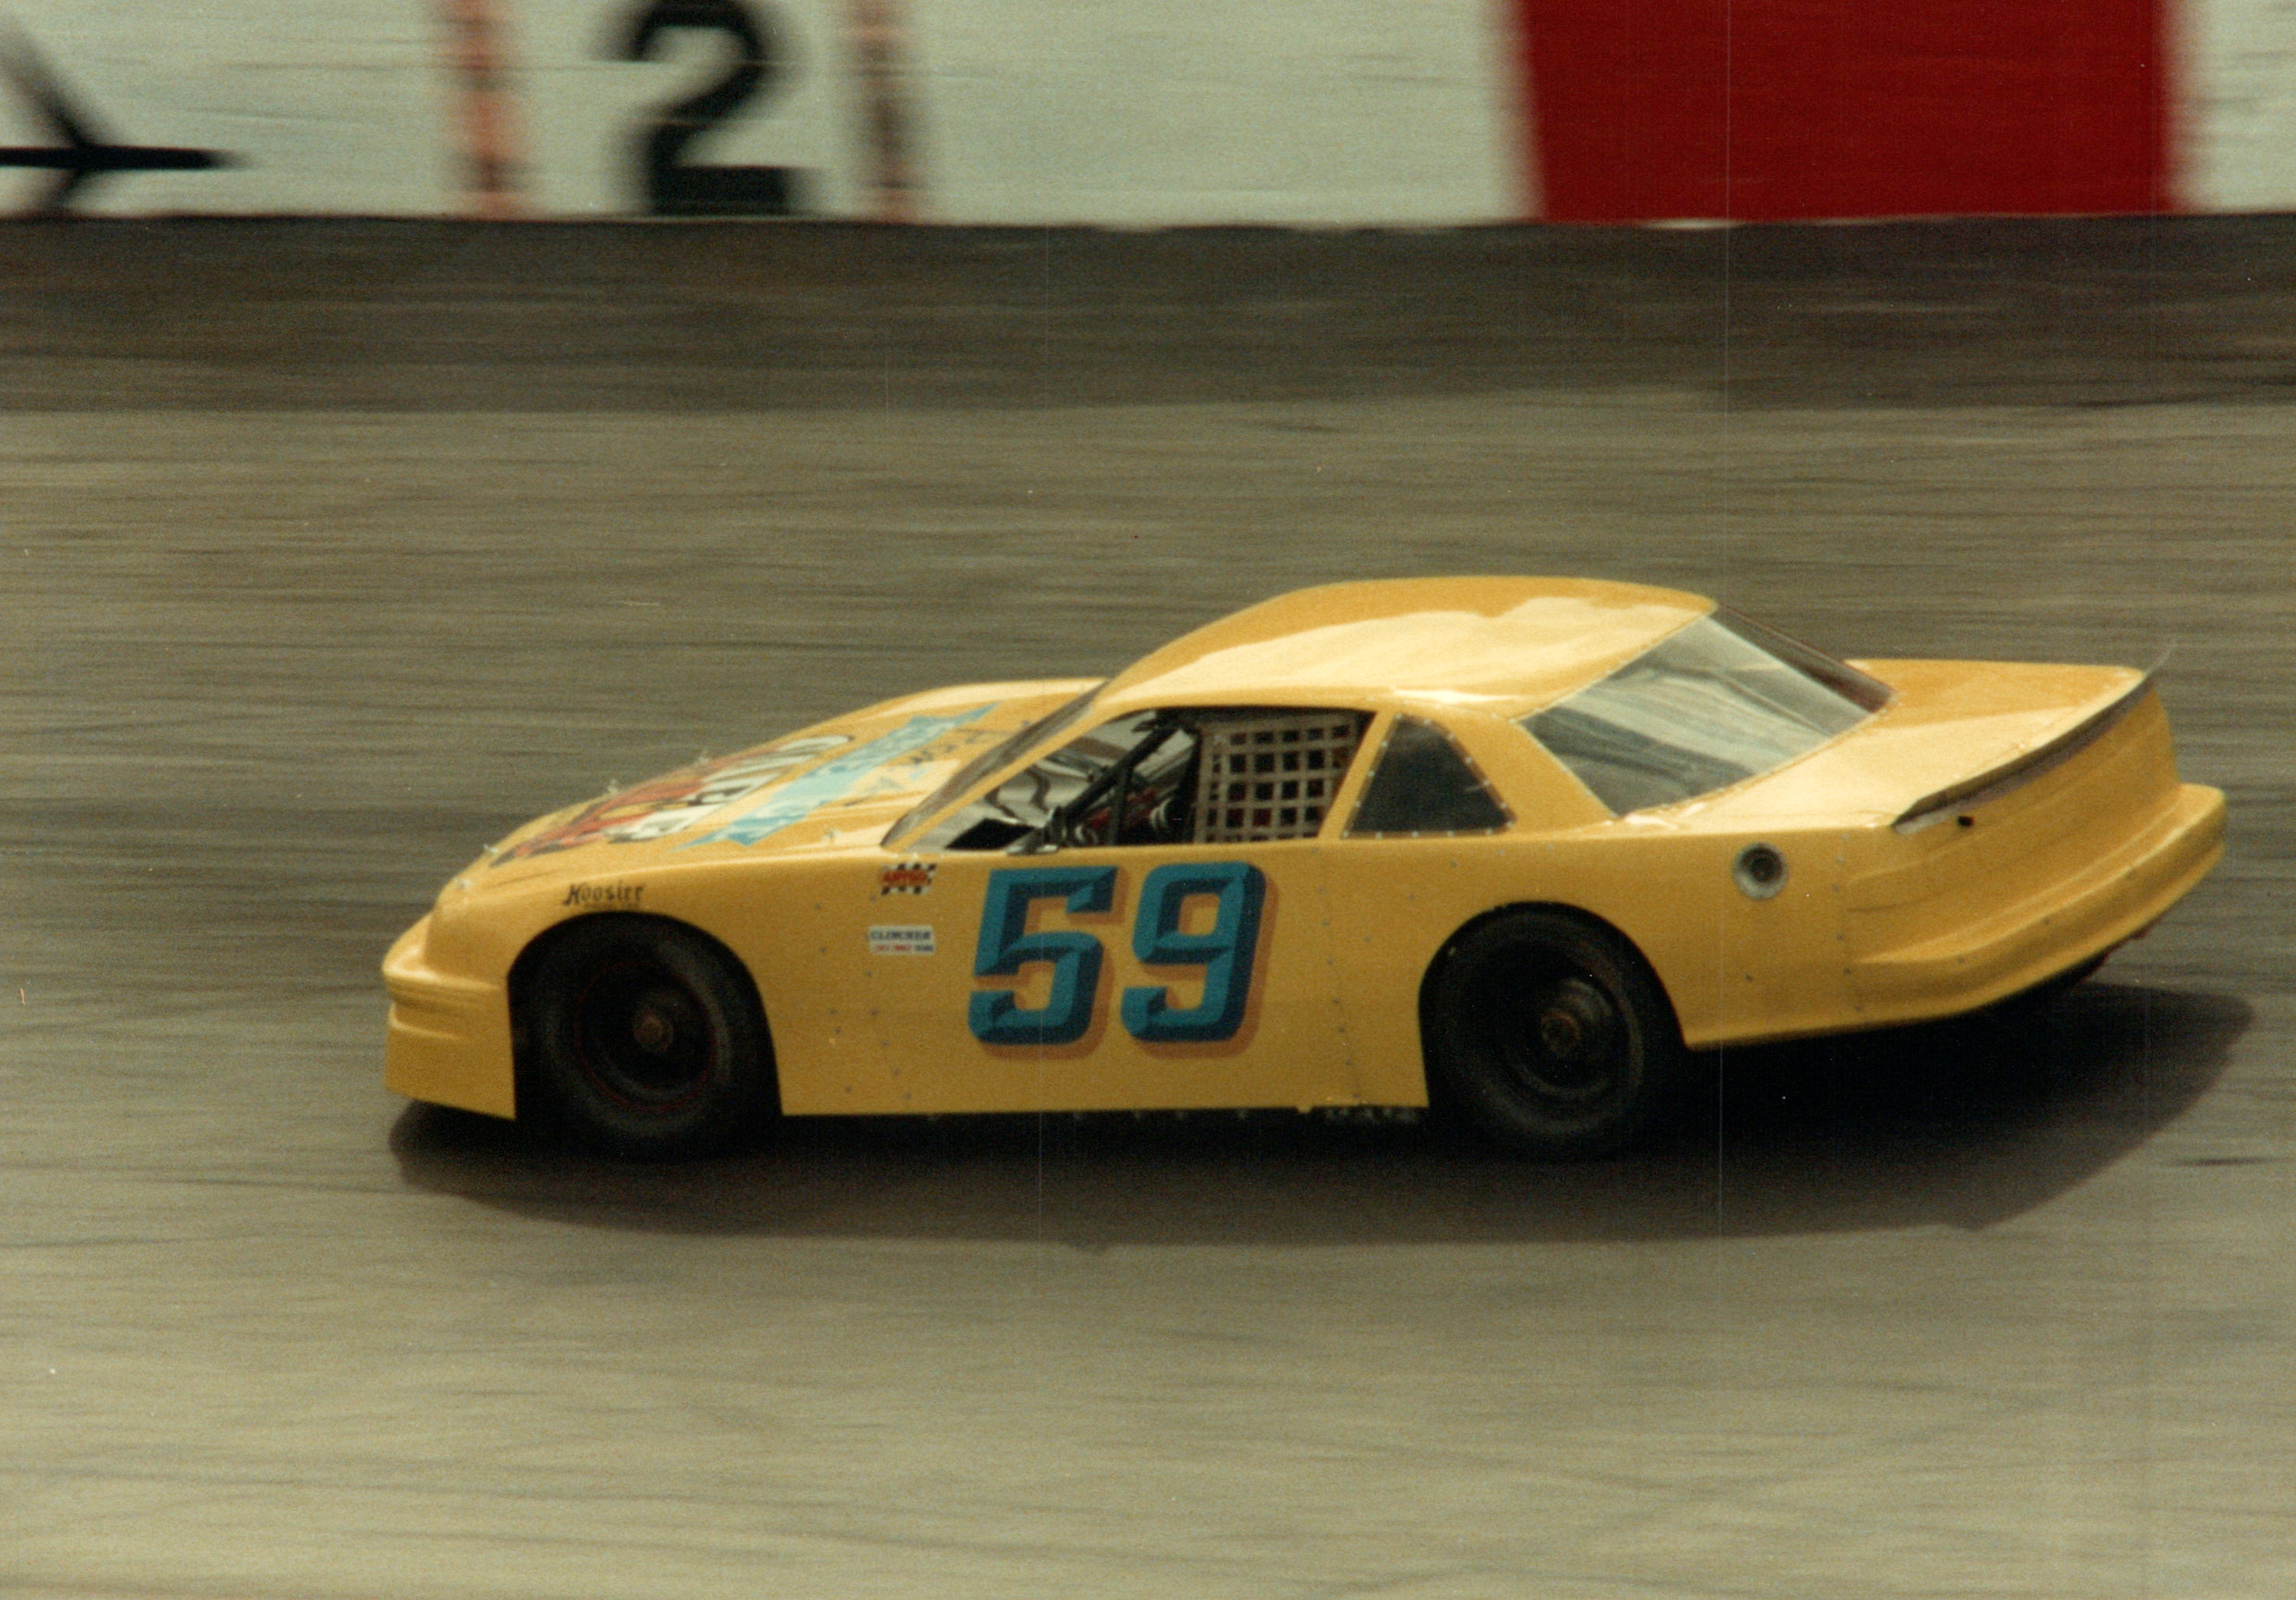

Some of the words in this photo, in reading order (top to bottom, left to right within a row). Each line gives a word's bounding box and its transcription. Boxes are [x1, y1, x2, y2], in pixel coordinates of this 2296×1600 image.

[616, 0, 809, 215] 2
[562, 880, 646, 905] Hoosier
[968, 860, 1276, 1058] 59
